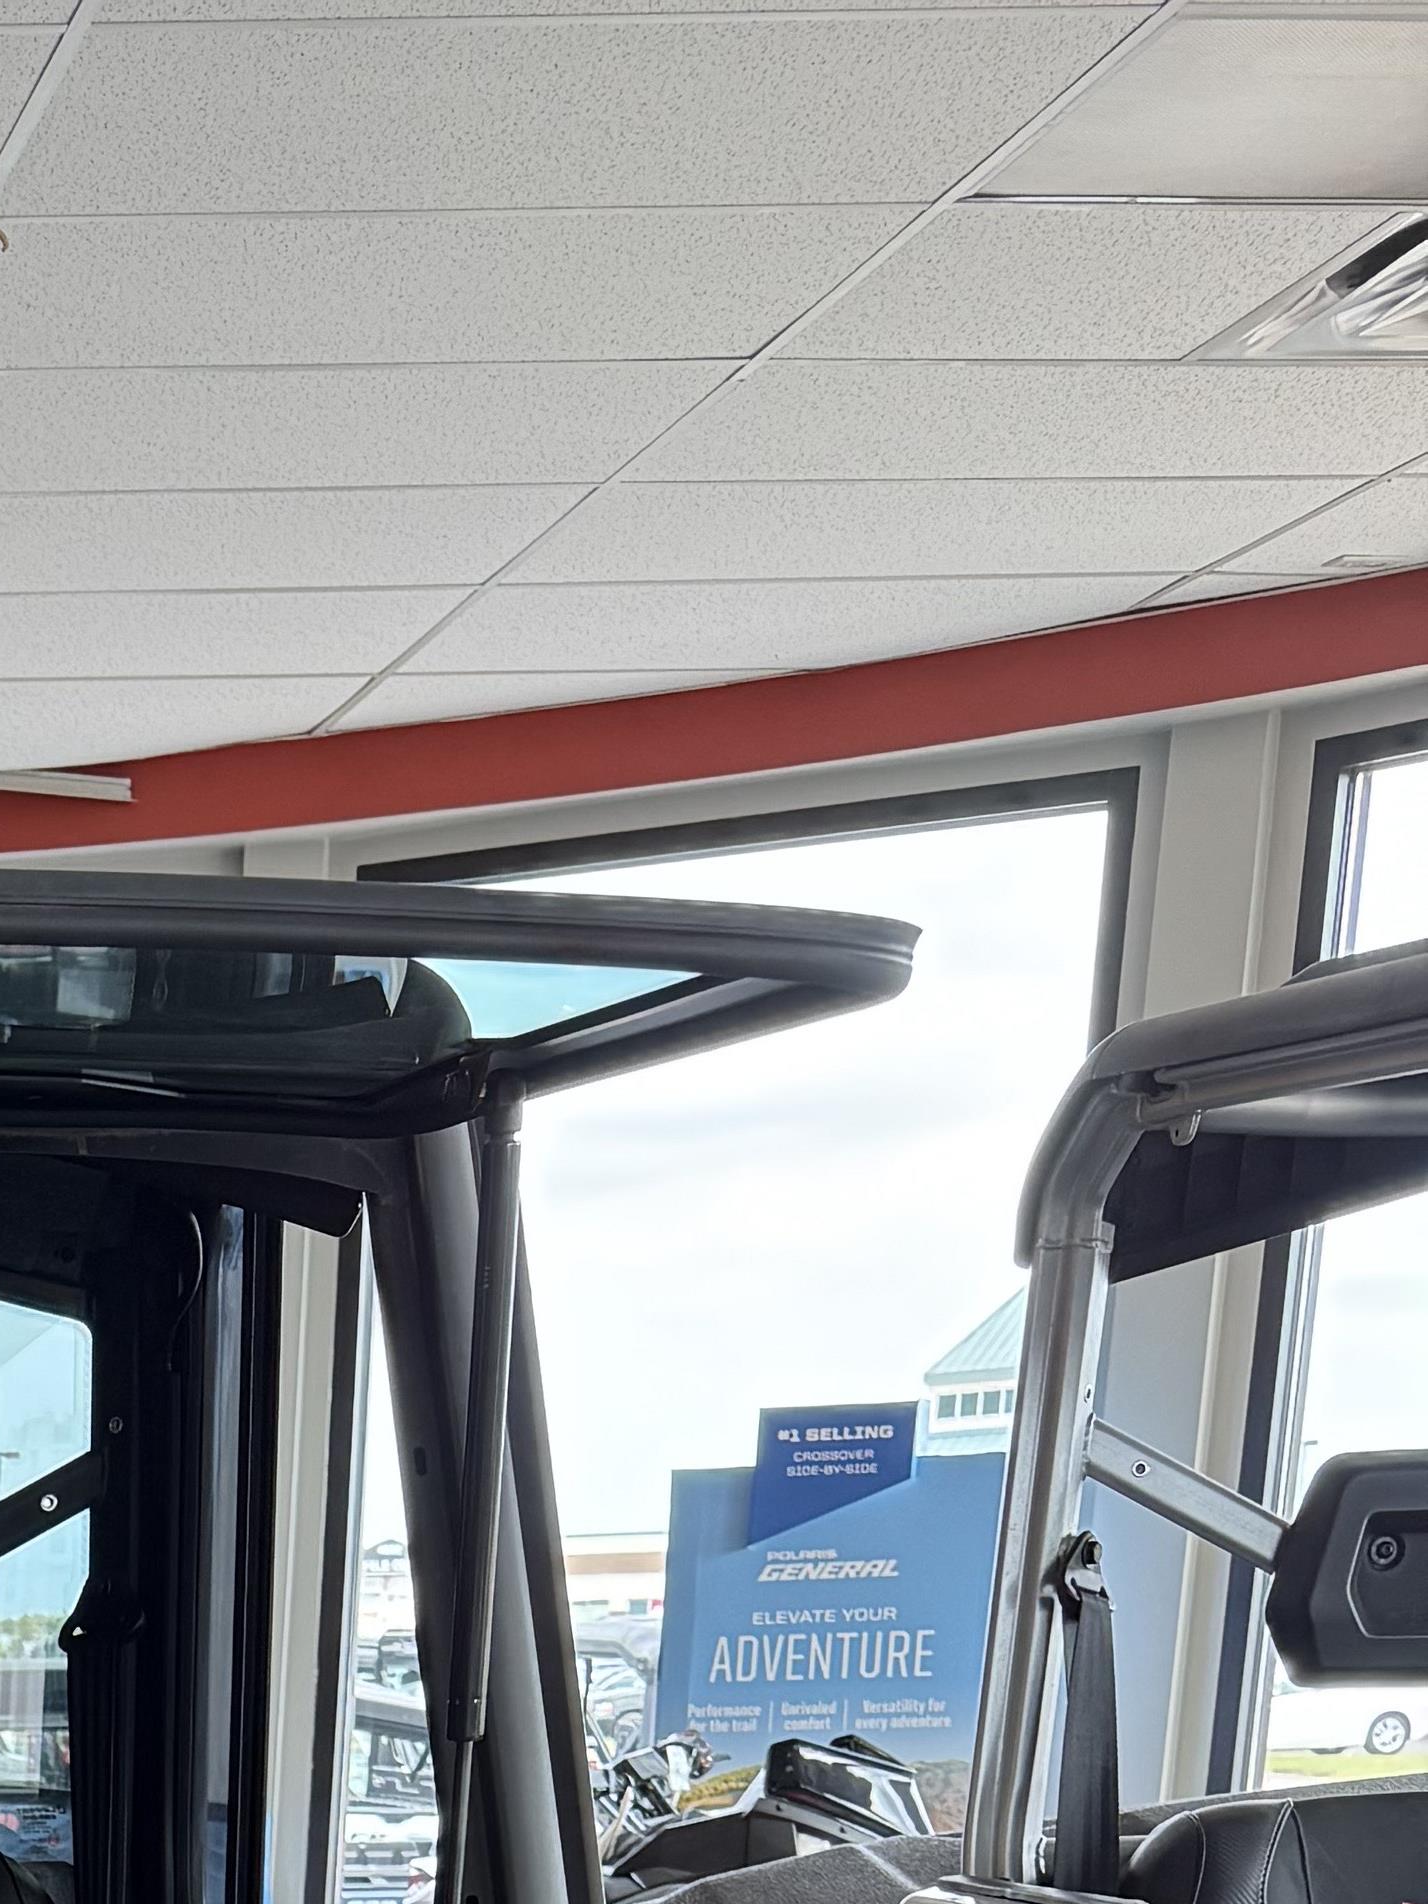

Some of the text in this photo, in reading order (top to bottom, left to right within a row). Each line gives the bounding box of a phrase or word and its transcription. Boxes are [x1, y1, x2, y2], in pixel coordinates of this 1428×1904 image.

[805, 1425, 894, 1442] SELLING
[793, 1448, 875, 1463] CROSSOVER
[786, 1462, 879, 1477] SIDE-BY-SIDE
[766, 1549, 838, 1561] POLARIS
[757, 1559, 900, 1582] GENERAL
[752, 1606, 897, 1625] ELEVATE YOUR
[709, 1629, 936, 1684] ADVENTURE
